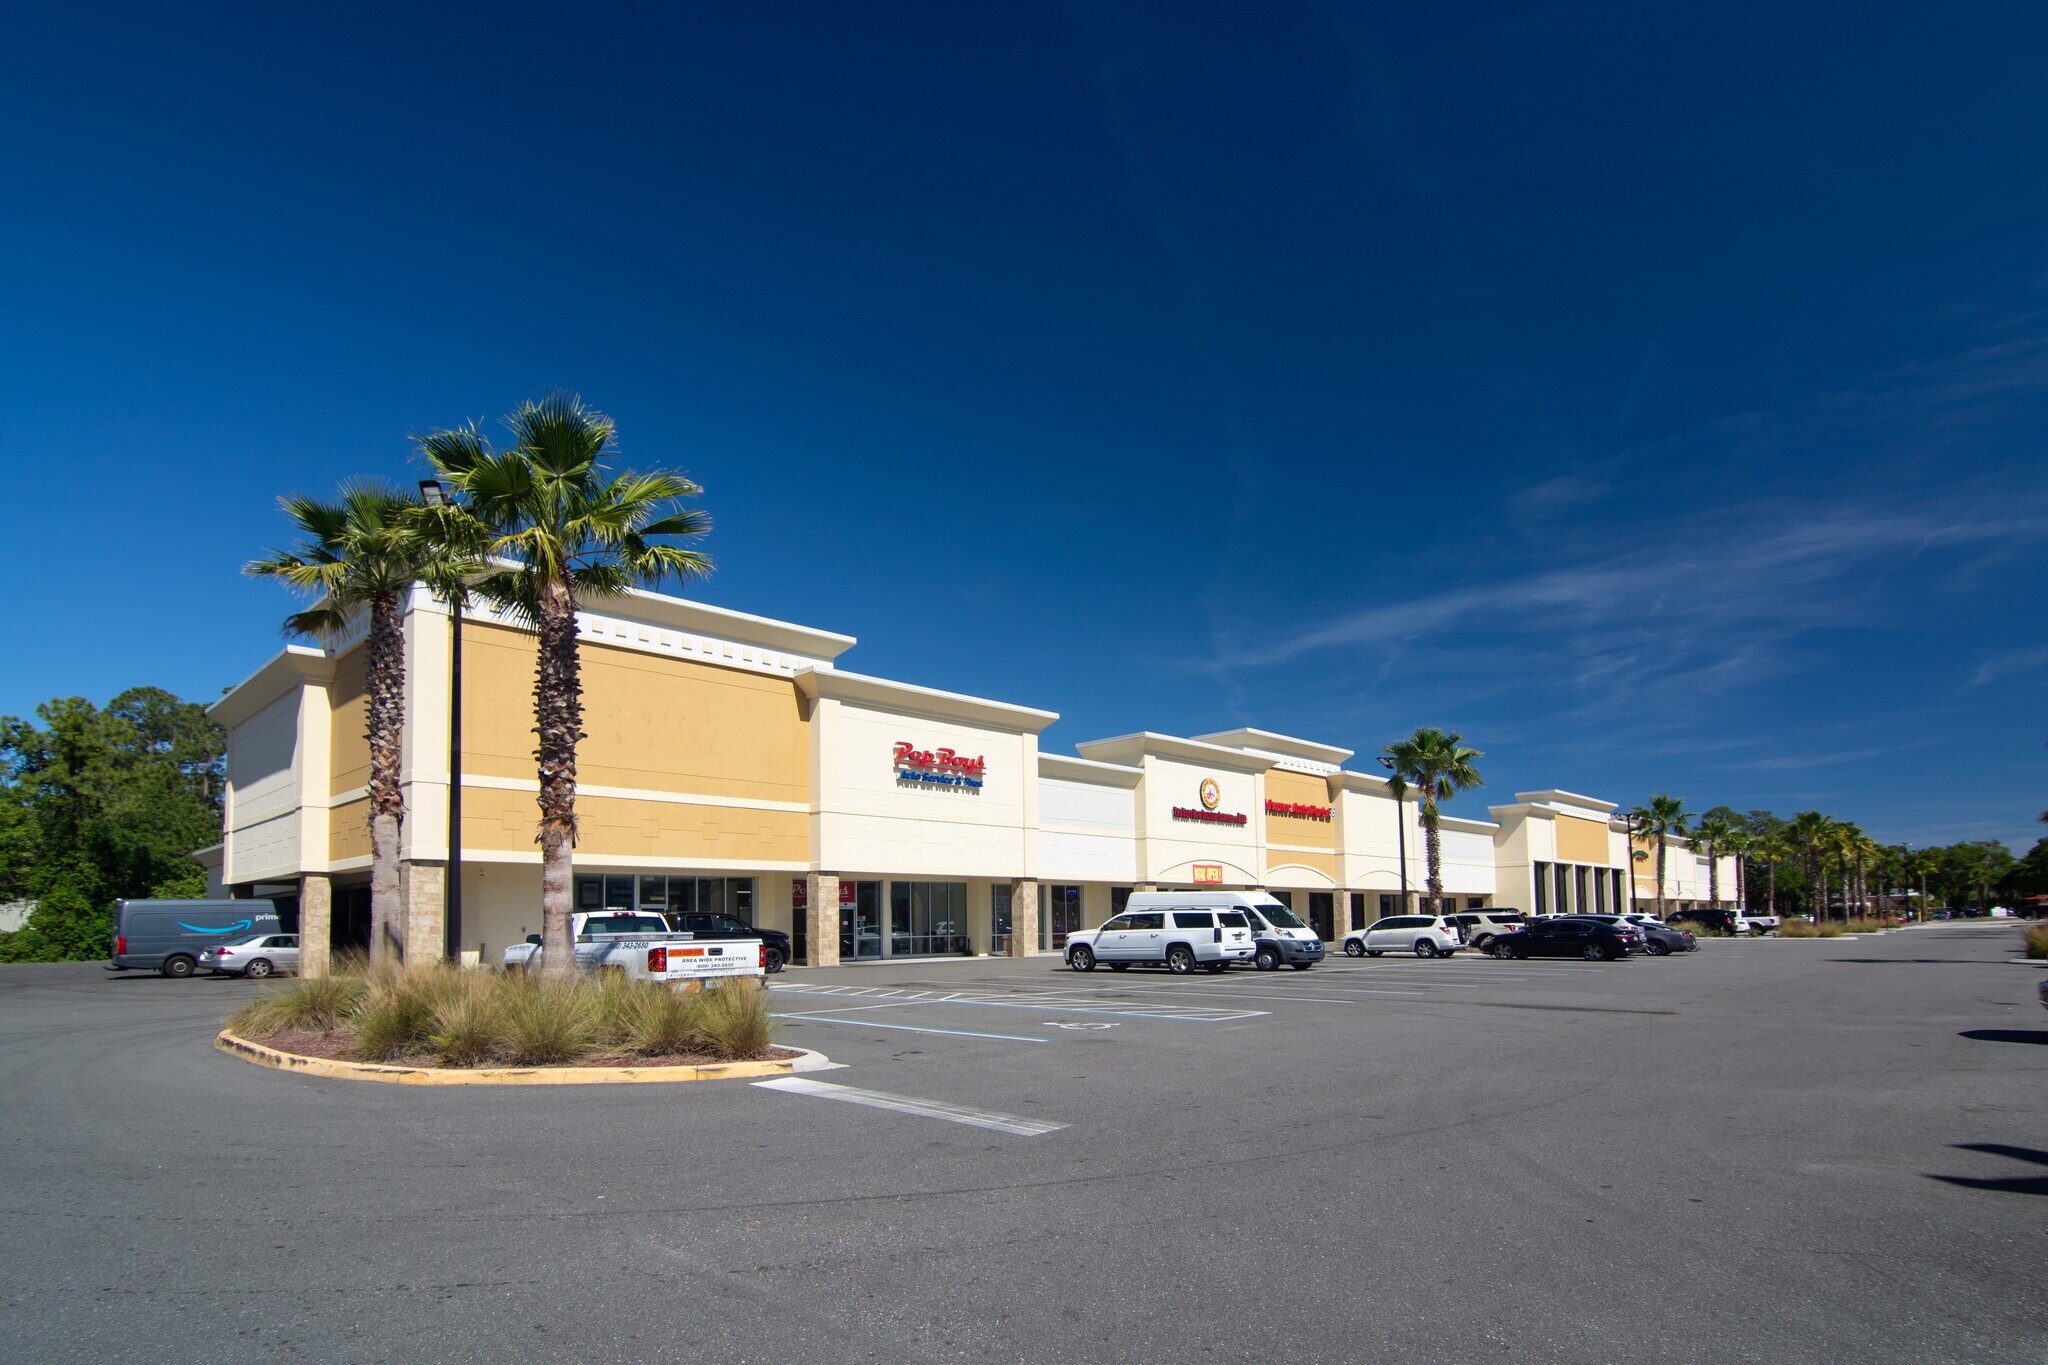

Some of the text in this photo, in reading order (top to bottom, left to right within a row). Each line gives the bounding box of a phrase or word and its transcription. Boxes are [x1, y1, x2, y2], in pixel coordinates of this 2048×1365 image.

[894, 741, 985, 775] Pep Boys
[901, 770, 921, 780] Auto
[922, 772, 954, 784] Service
[255, 913, 281, 921] prime
[622, 941, 648, 949] 343-2650
